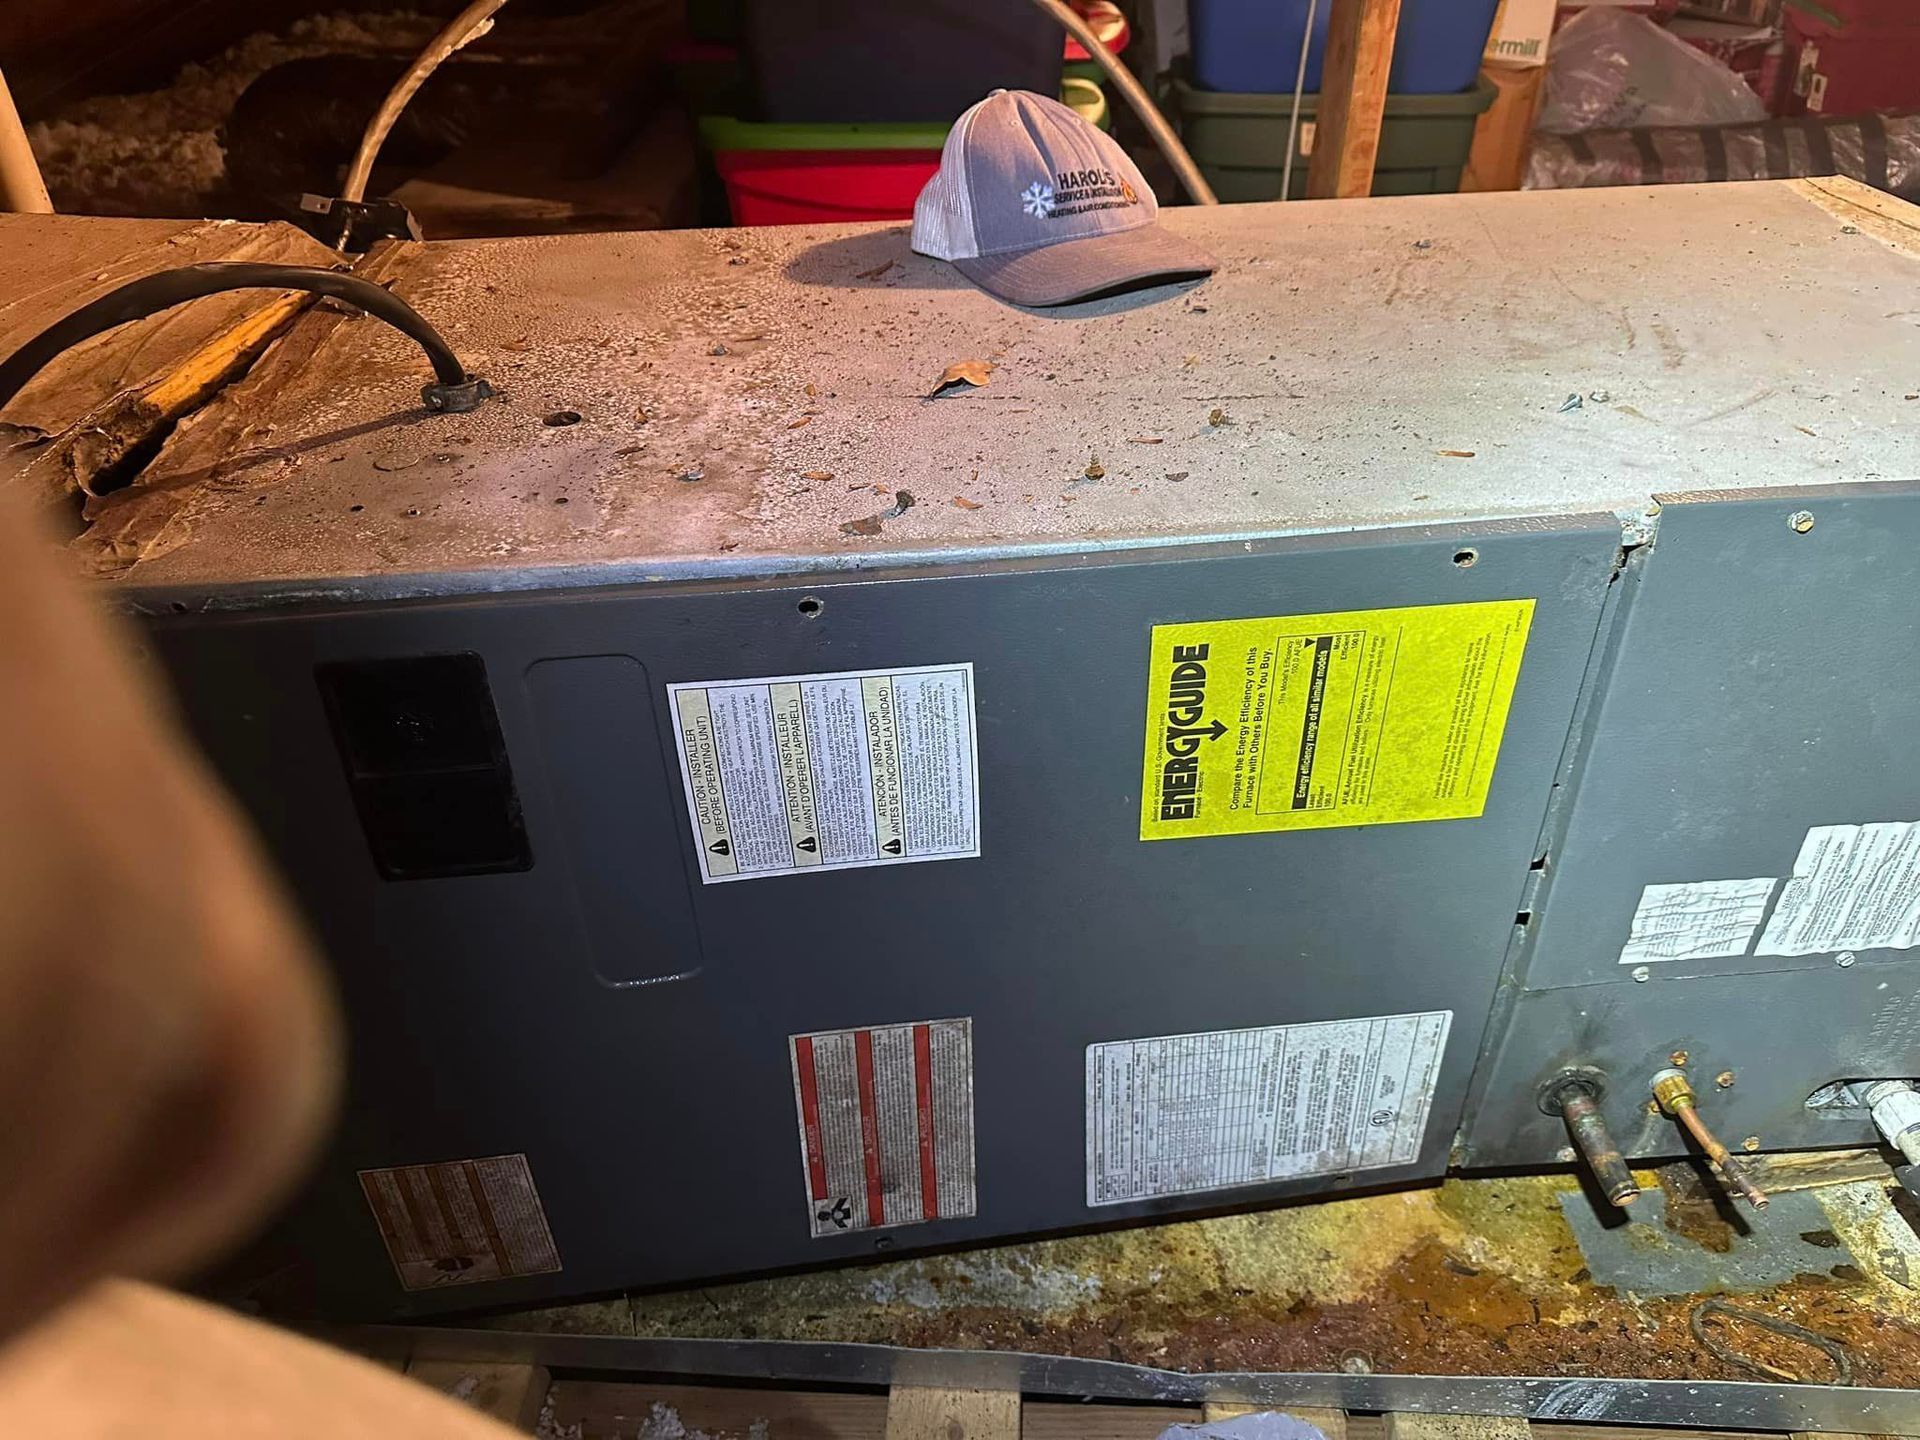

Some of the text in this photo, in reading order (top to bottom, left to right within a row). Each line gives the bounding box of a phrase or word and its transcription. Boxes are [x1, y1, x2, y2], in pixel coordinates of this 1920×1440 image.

[1054, 189, 1084, 204] SERVICE
[1058, 168, 1115, 190] HAROL'S
[1047, 206, 1077, 219] HEATING
[1339, 634, 1350, 660] Efficient
[777, 712, 793, 768] INSTALLEUR
[868, 711, 882, 767] INSTALADOR
[1160, 643, 1209, 820] ENERGYGUIDE
[1229, 647, 1257, 809] Compare the Energy Efficiency of this
[1243, 647, 1271, 808] Furnace with Others Before You Buy.
[1296, 649, 1329, 797] Energy efficiency range of all similar models
[684, 729, 702, 778] INSTALLER
[695, 715, 726, 834] (BEFORE OPERATING UNIT)
[879, 685, 901, 836] (ANTES DE FUNCIONAR LA UNIDAD)
[694, 785, 710, 824] CAUTION
[785, 775, 800, 822] ATTENTION
[801, 804, 814, 833] (AVANT
[873, 774, 887, 817] ATENCIÓN
